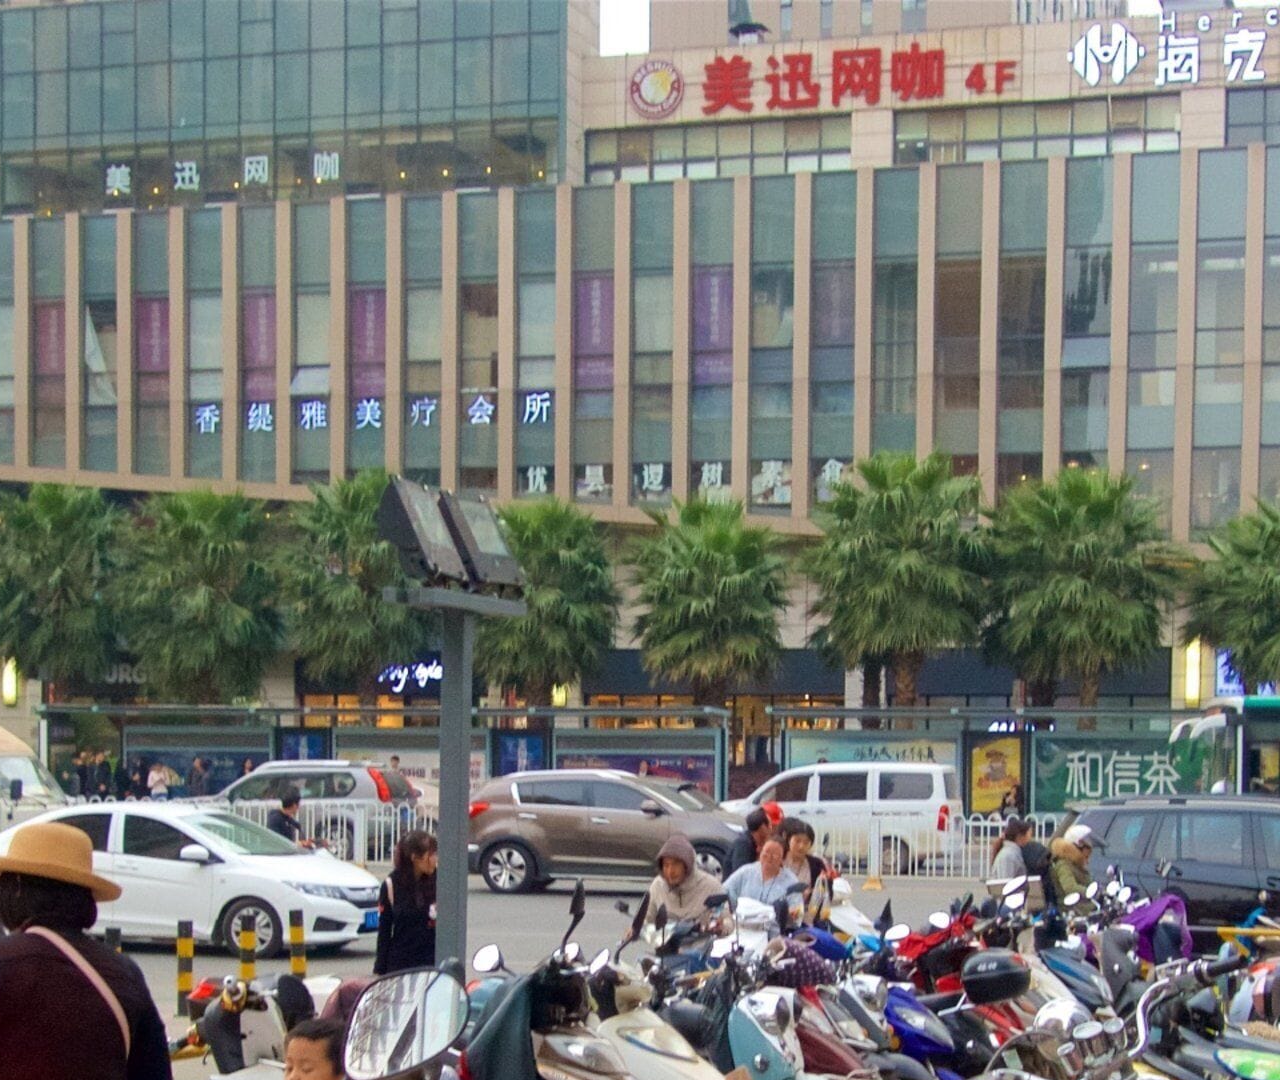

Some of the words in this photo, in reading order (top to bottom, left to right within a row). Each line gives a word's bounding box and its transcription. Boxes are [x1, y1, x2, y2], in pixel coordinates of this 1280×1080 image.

[701, 42, 945, 116] 美迅网咖
[965, 61, 1017, 95] 4F
[106, 152, 340, 194] 美迅网咖
[1065, 750, 1181, 799] 和信茶
